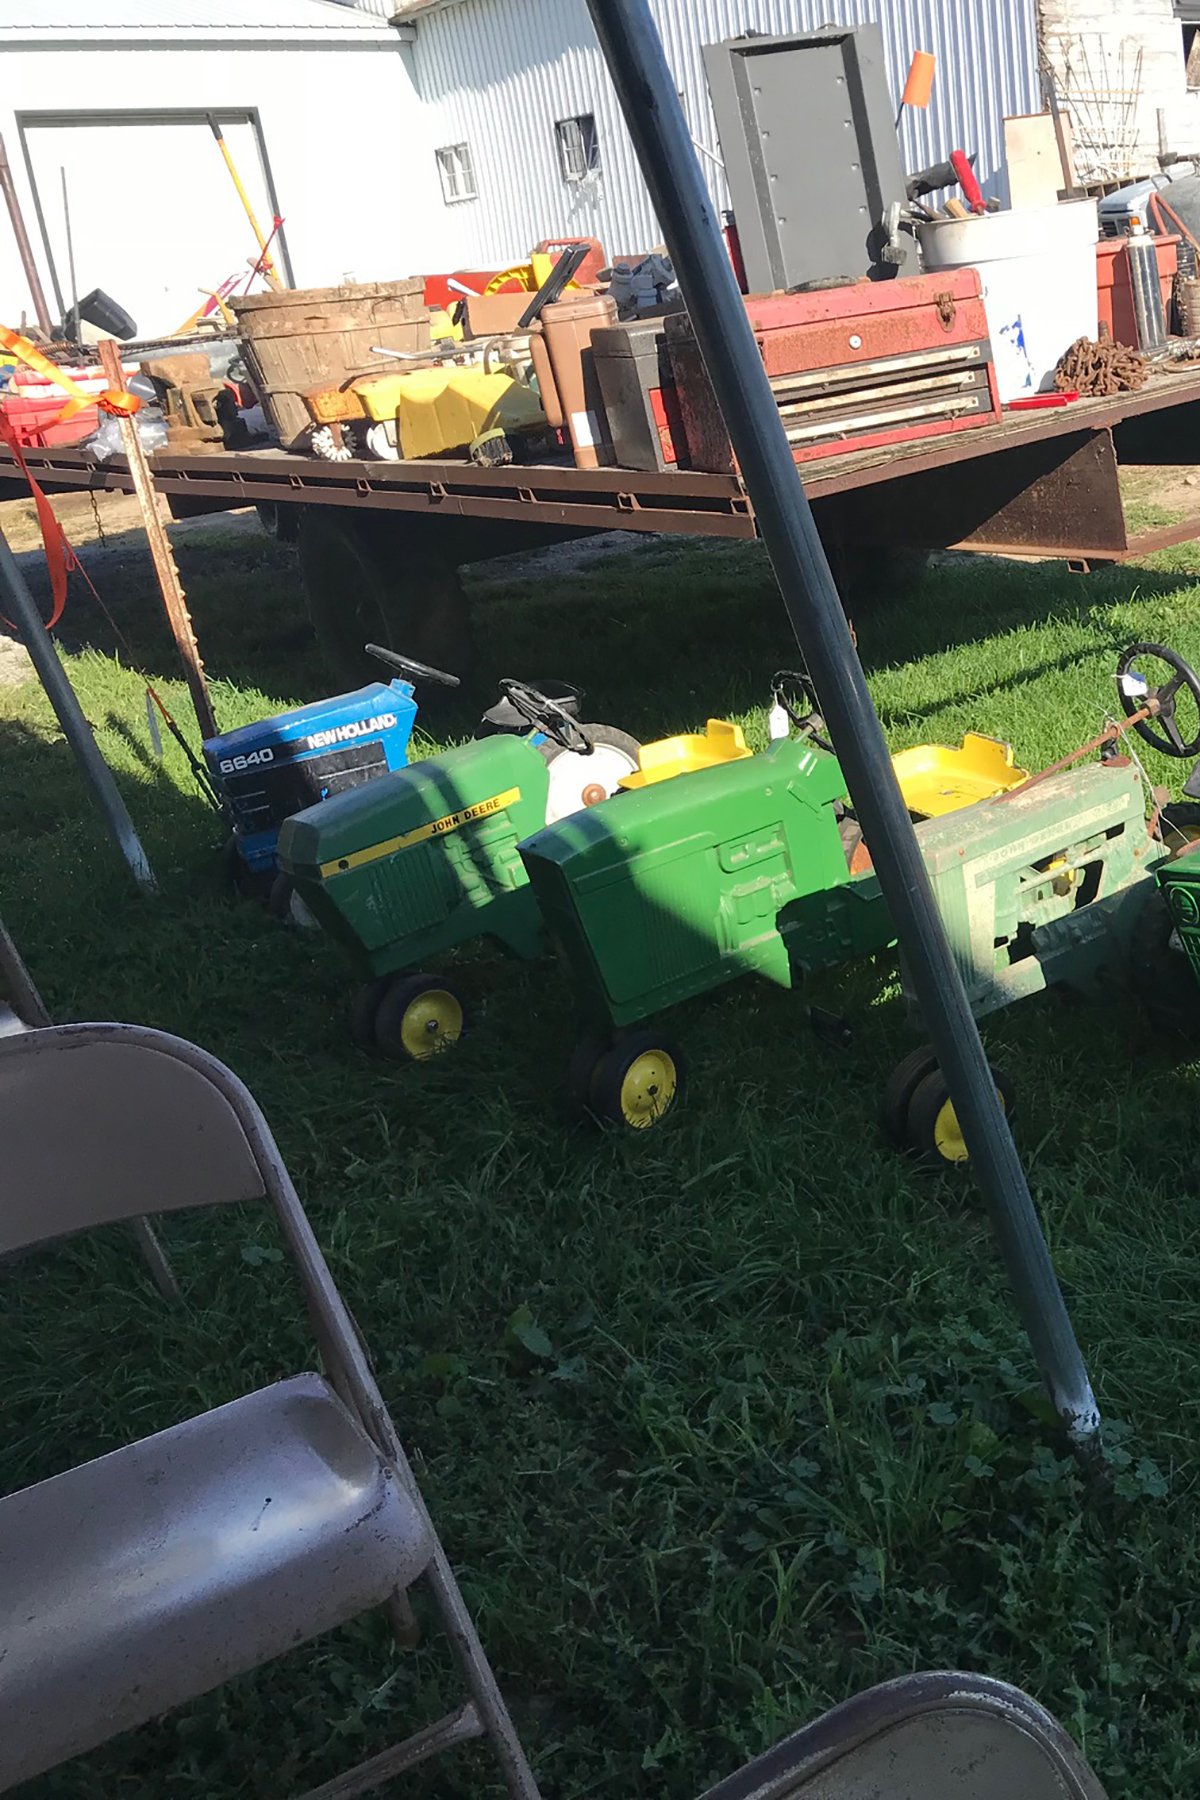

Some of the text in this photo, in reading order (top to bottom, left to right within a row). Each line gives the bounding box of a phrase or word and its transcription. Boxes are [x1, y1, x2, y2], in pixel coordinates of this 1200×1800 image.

[306, 713, 396, 750] NEW HOLLAND
[219, 748, 275, 774] 6640
[431, 798, 501, 835] JOHN DEERE
